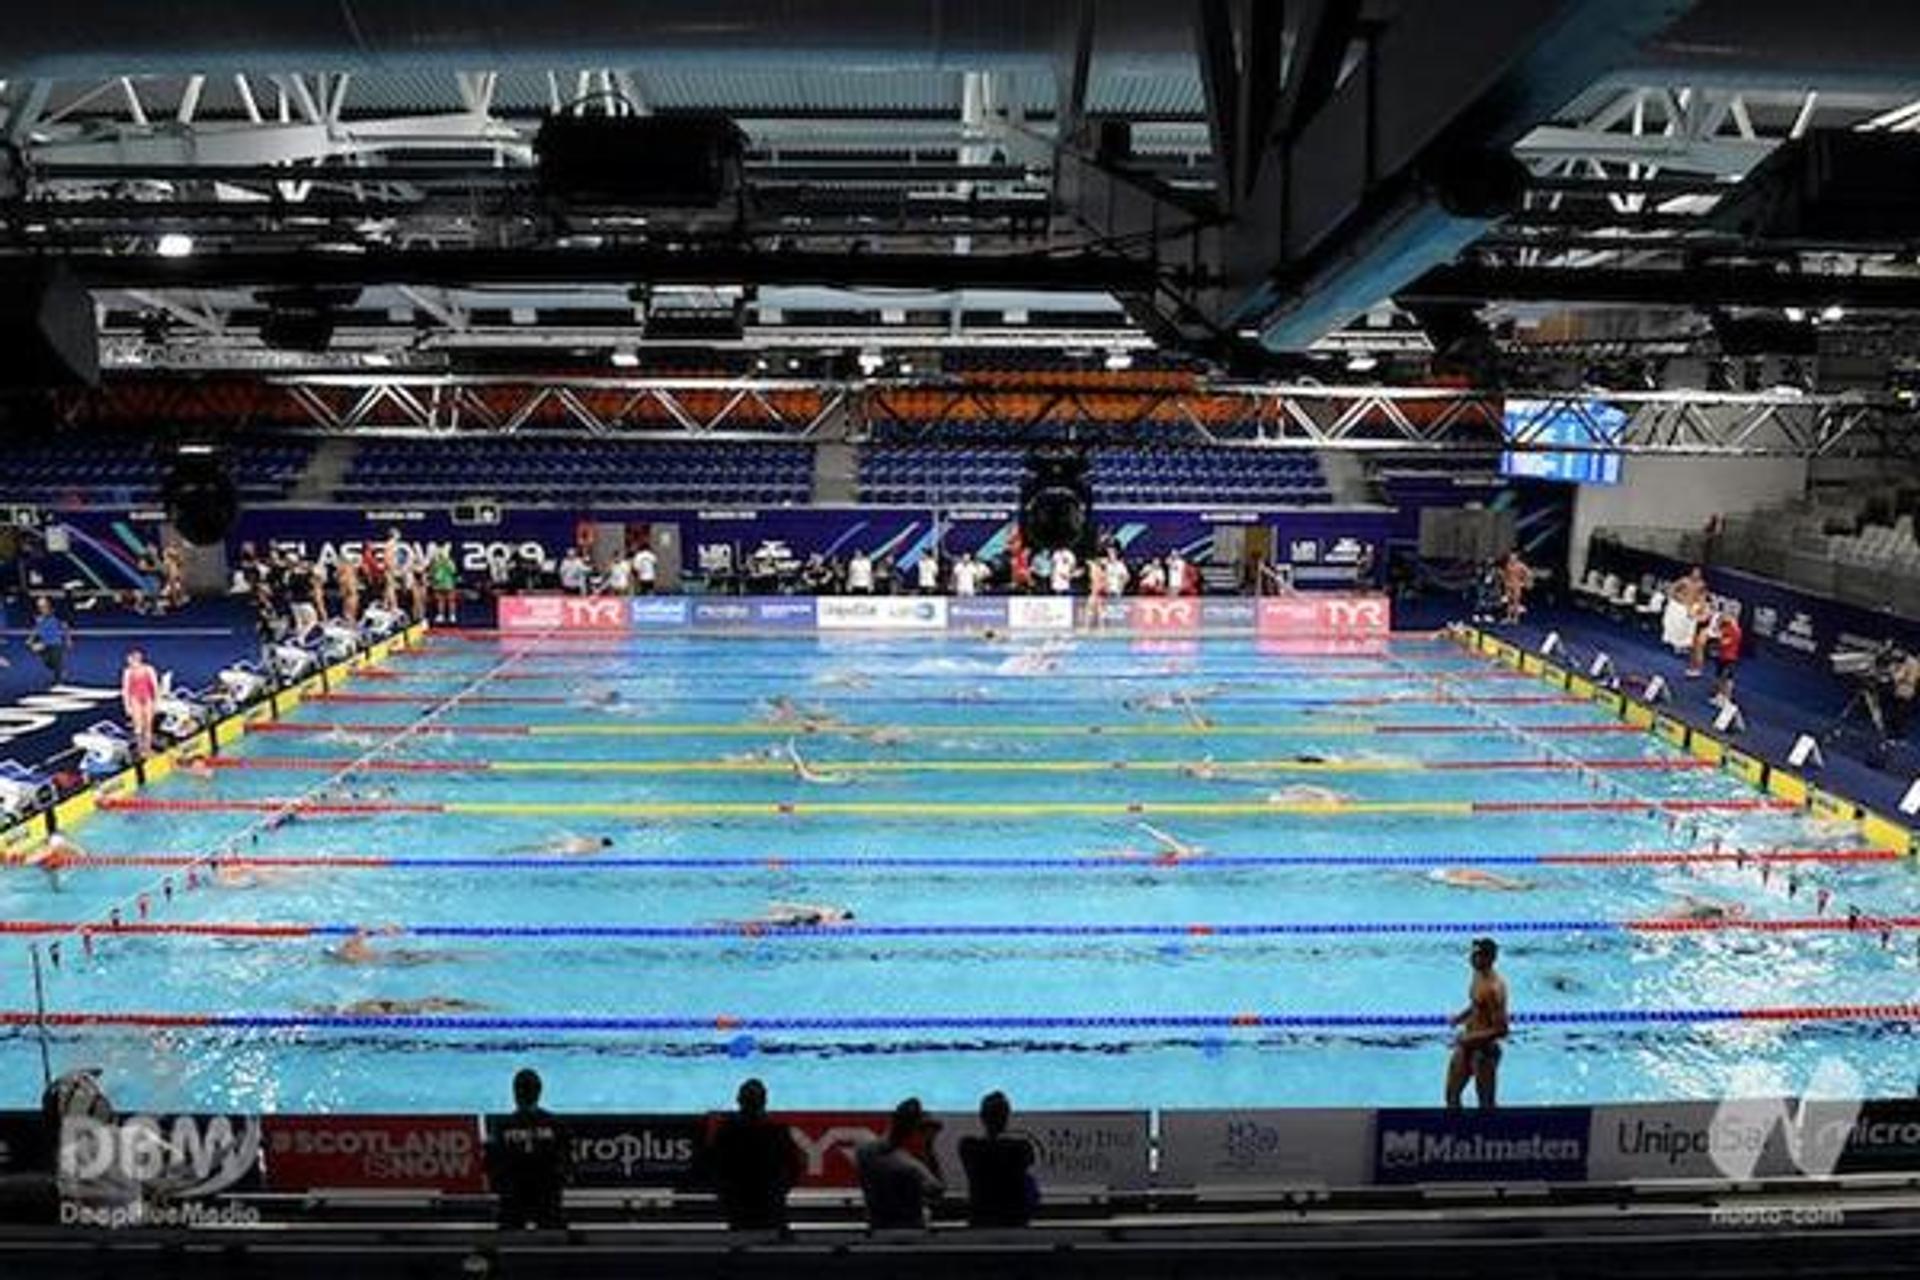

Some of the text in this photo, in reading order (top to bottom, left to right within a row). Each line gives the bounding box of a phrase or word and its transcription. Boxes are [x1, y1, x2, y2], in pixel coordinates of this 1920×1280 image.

[462, 541, 545, 570] 209
[566, 601, 620, 625] TYR
[1142, 601, 1192, 625] TYR
[1327, 601, 1383, 625] TYR
[571, 1130, 692, 1177] roplus
[1424, 1133, 1580, 1163] Malmsten
